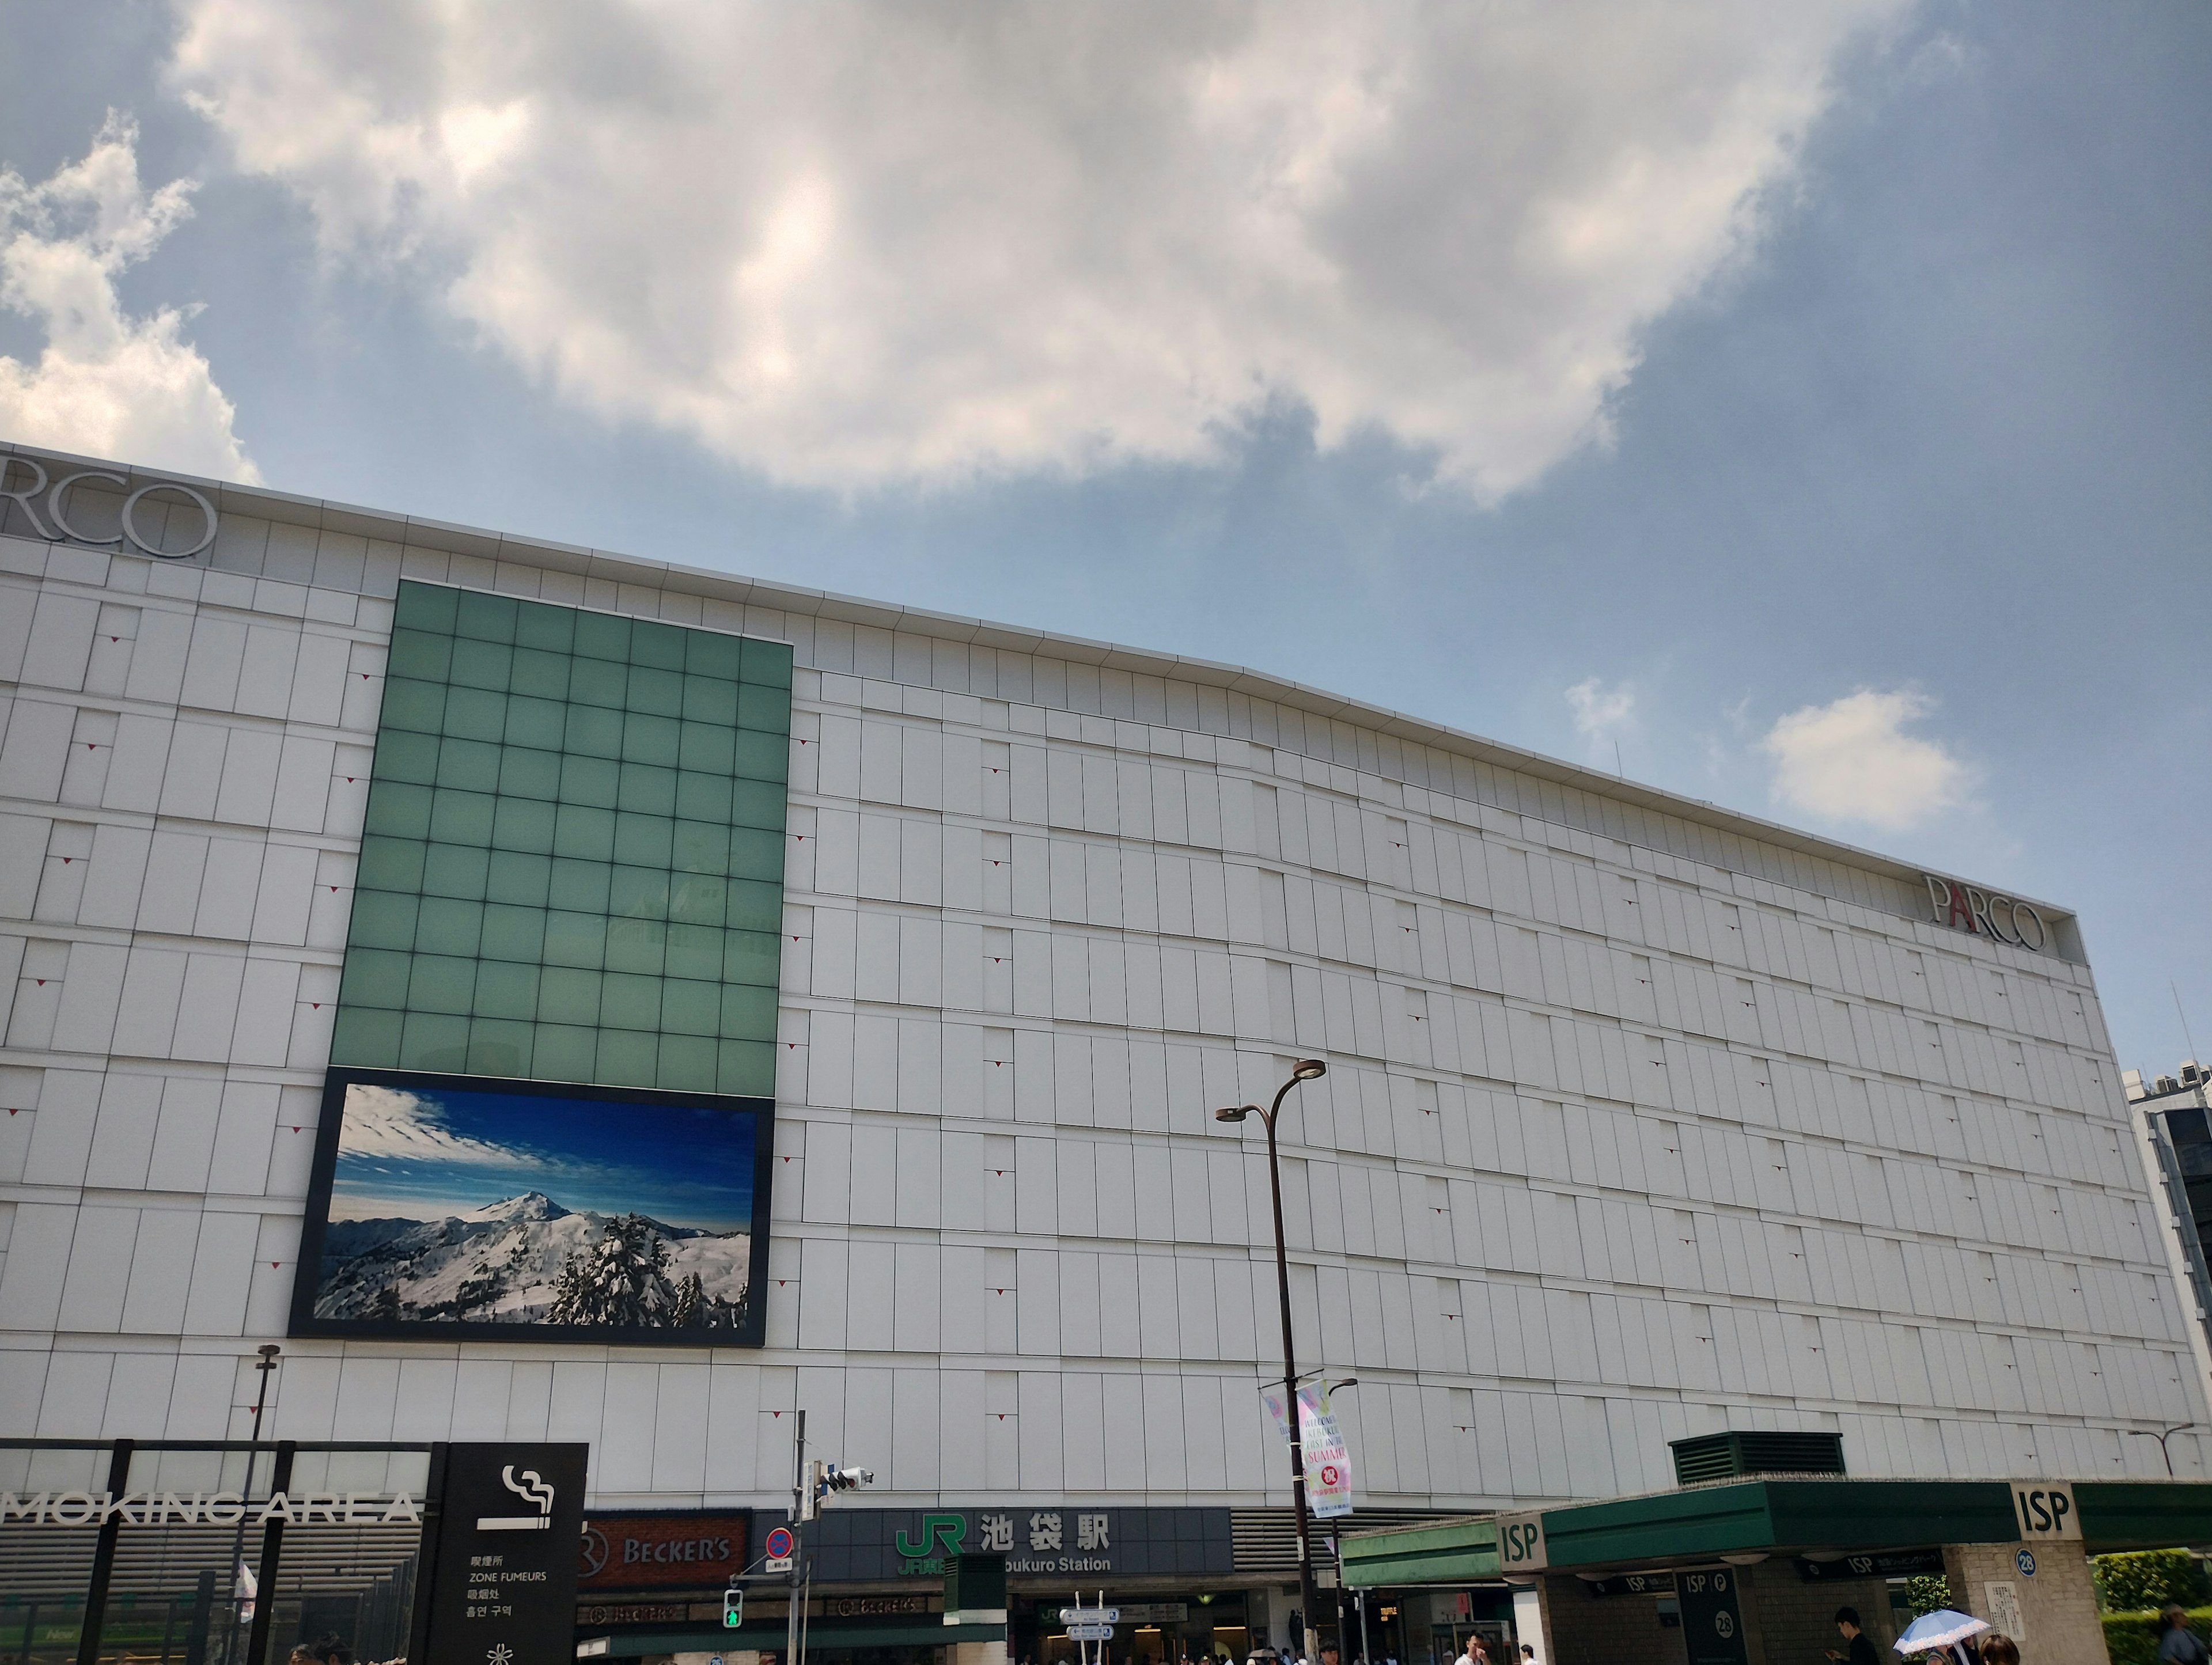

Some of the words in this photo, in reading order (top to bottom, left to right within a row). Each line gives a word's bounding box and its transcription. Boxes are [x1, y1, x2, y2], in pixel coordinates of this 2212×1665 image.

[1926, 875, 2046, 951] PARCO
[1308, 1447, 1346, 1463] SUMMER
[1324, 1468, 1336, 1483] 祝
[257, 1491, 421, 1524] AREA
[2018, 1490, 2069, 1531] ISP
[896, 1514, 967, 1557] JR
[980, 1512, 1110, 1552] 池袋駅
[623, 1537, 730, 1564] BECKER'S
[1502, 1523, 1539, 1562] ISP
[470, 1555, 503, 1567] 喫煙所
[1059, 1557, 1111, 1572] Station
[1847, 1557, 1873, 1573] ISP
[2019, 1554, 2033, 1572] 28
[469, 1572, 498, 1583] ZONE
[500, 1571, 547, 1582] FUMEURS
[1625, 1576, 1646, 1592] ISP
[1686, 1575, 1706, 1593] ISP
[467, 1588, 499, 1600] 吸烟处
[466, 1605, 487, 1618] 흡연
[491, 1605, 512, 1617] 구역
[1041, 1609, 1058, 1620] JR
[1717, 1617, 1732, 1632] 28
